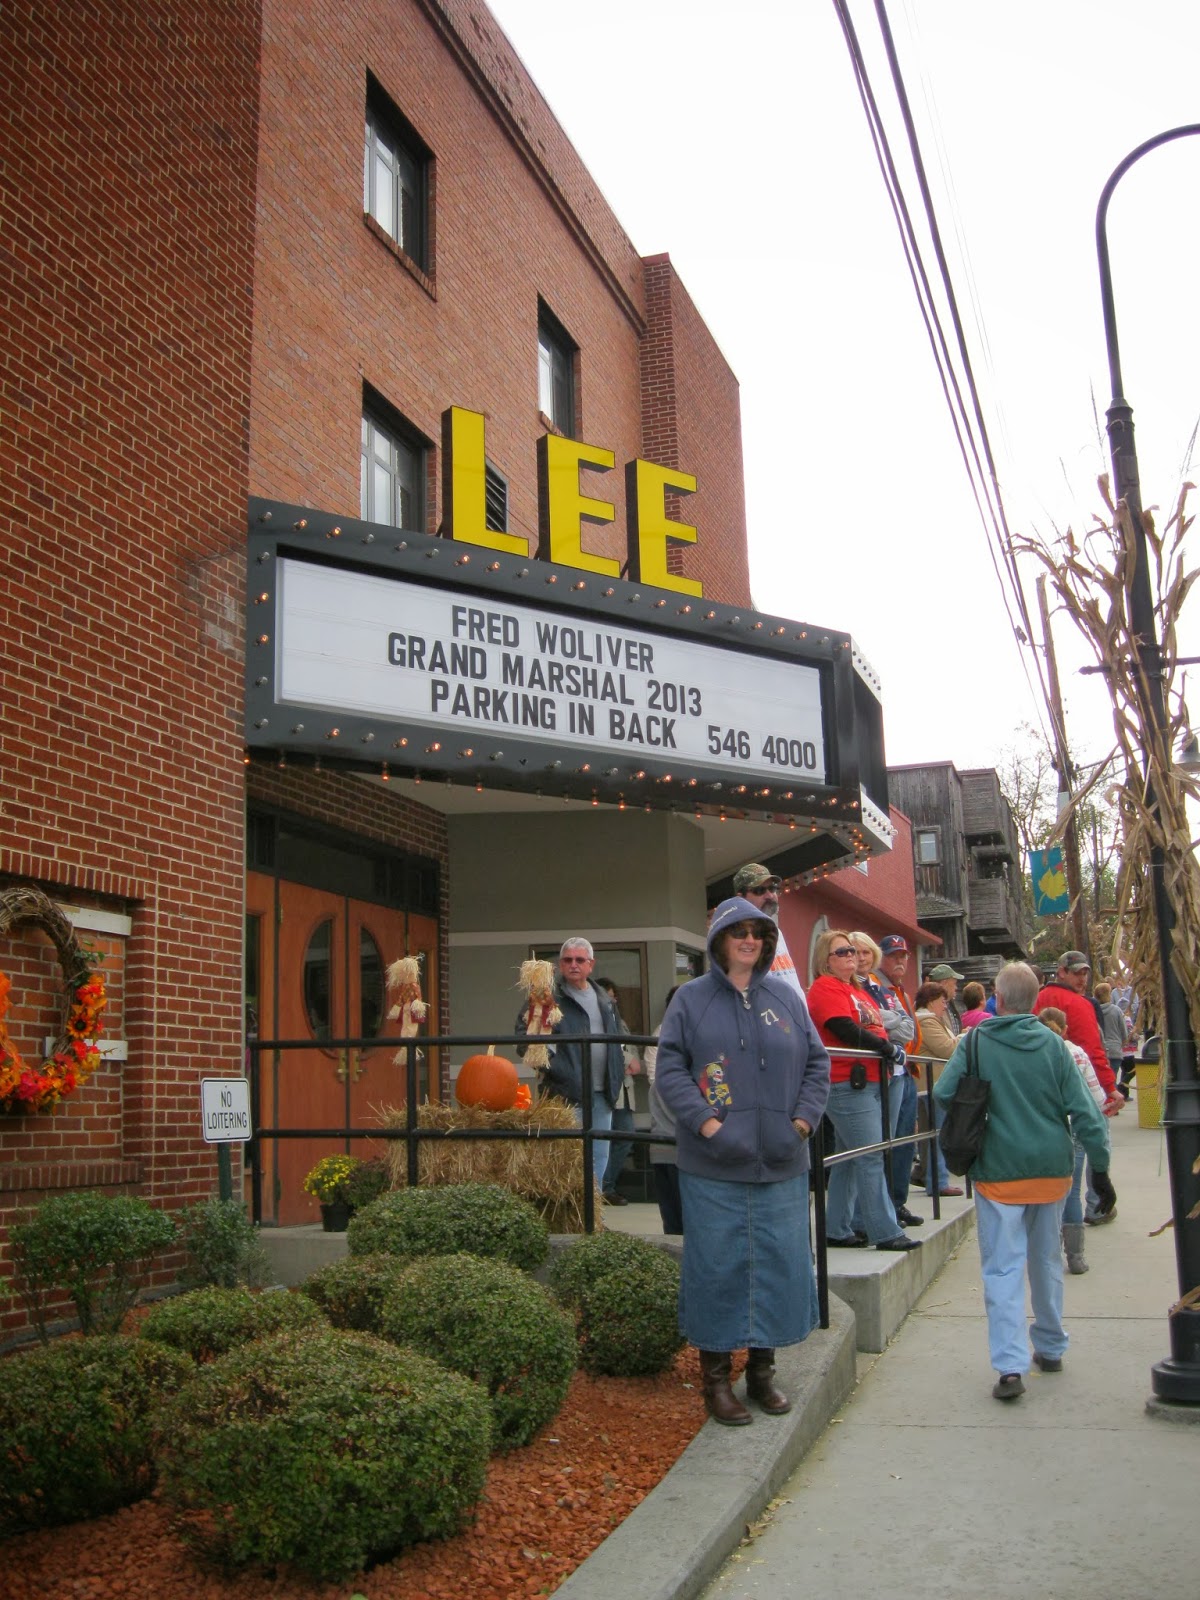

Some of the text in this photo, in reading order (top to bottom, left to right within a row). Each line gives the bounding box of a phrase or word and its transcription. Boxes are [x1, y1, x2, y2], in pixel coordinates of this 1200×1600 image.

[442, 405, 703, 599] LEE
[388, 632, 702, 717] GRAND MARSHAL 2013
[451, 604, 654, 674] FRED WOLIVER
[431, 678, 816, 770] PARKING IN BACK 546 4000
[207, 1111, 248, 1130] LOITERING
[220, 1090, 233, 1108] NO
